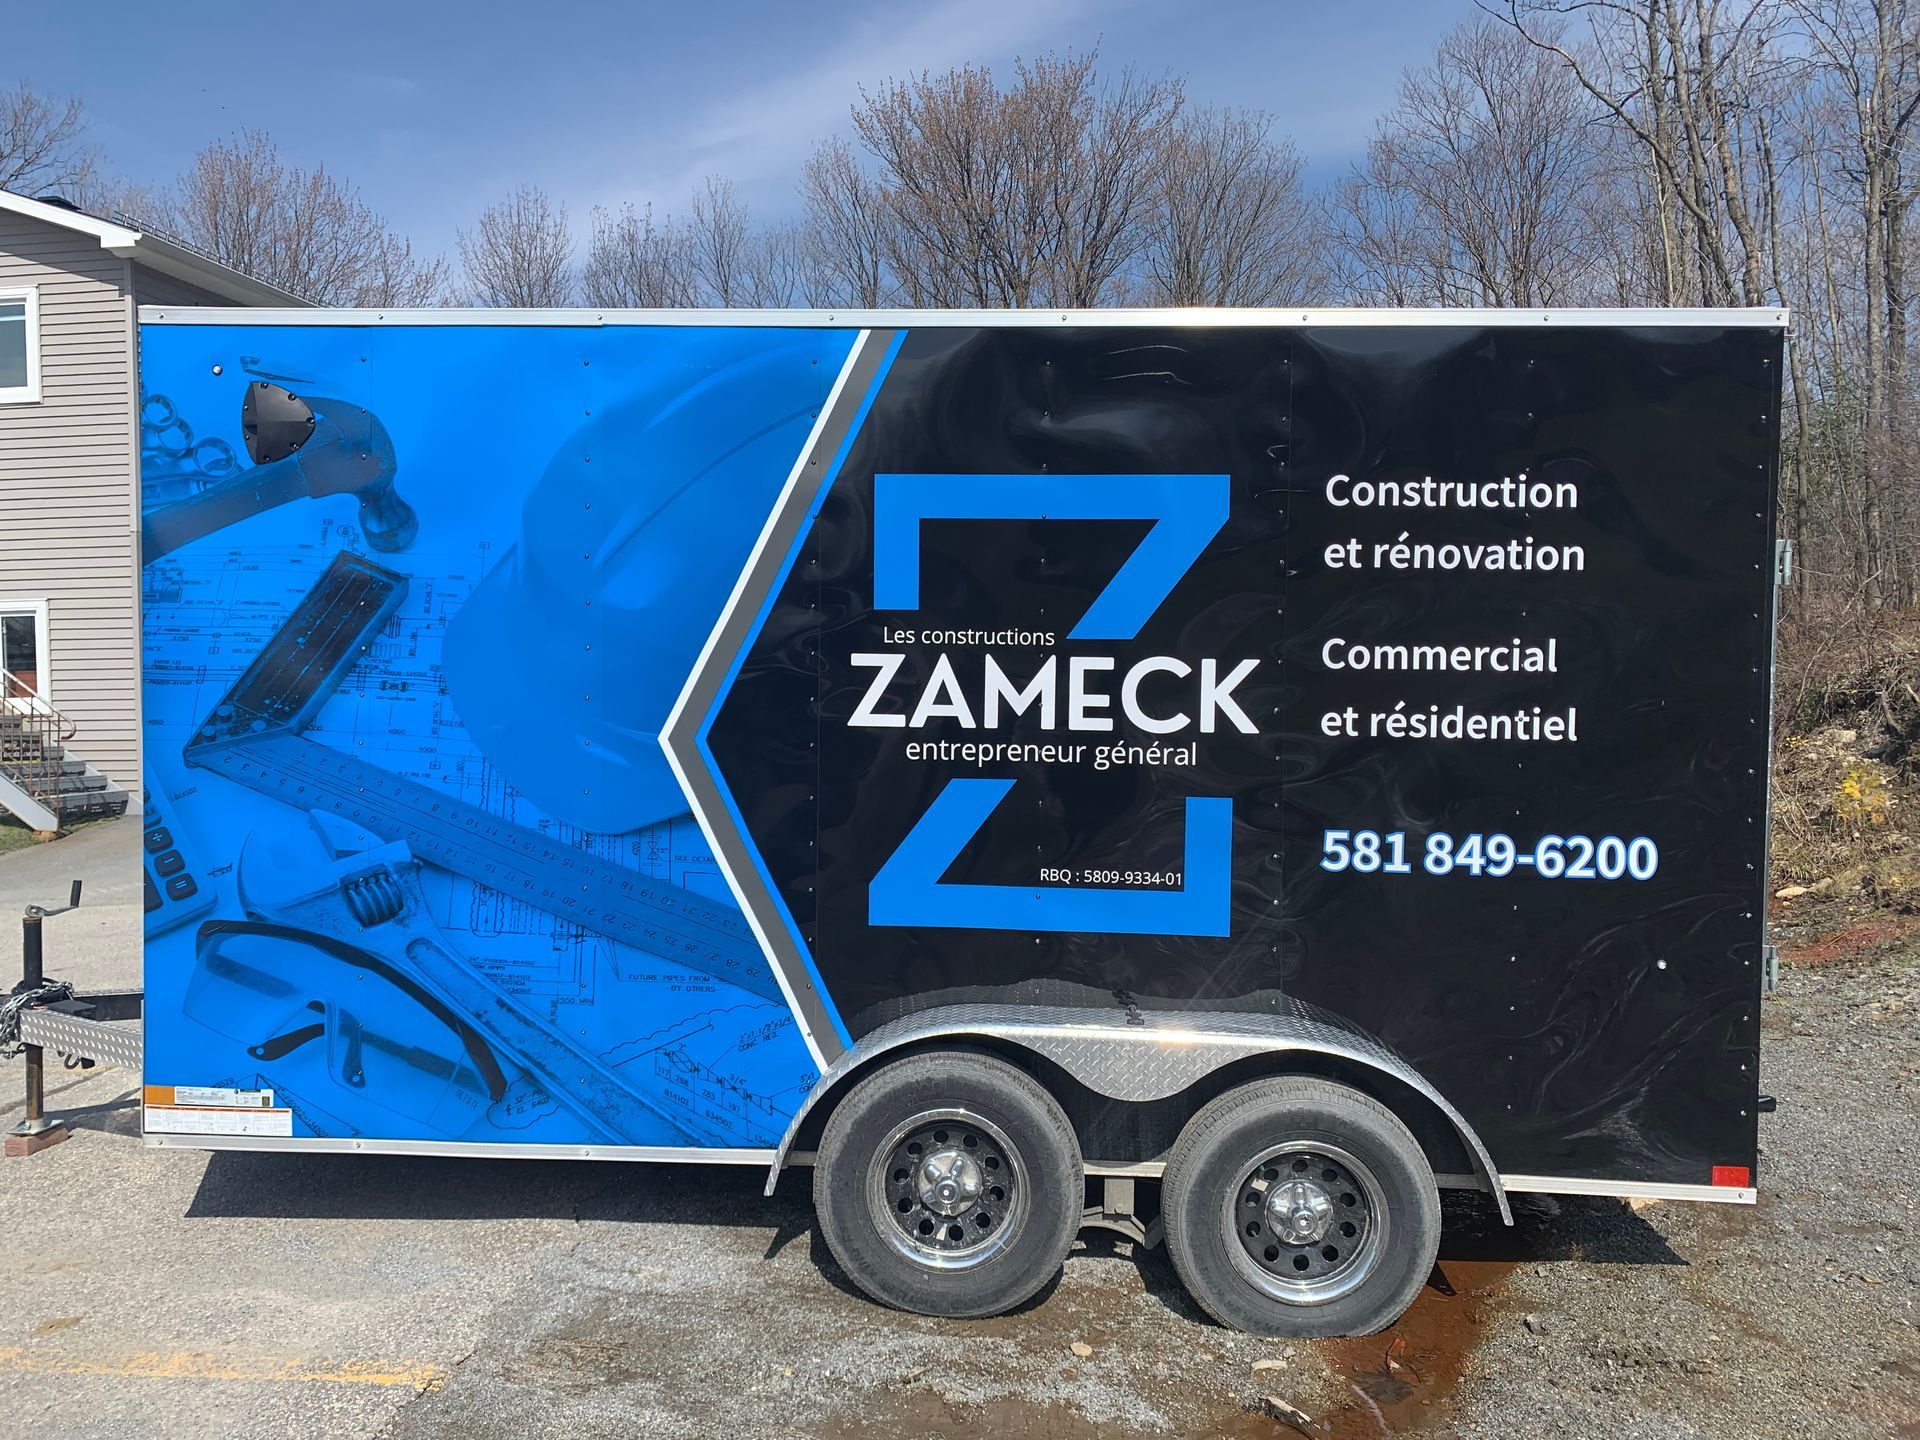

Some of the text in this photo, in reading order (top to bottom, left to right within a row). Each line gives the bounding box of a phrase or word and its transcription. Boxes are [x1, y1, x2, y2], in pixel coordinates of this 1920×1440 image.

[1325, 474, 1578, 508] Construction
[1324, 531, 1585, 571] et rénovation
[883, 626, 1056, 646] Les constructions
[1321, 638, 1557, 673] Commercial
[847, 652, 1261, 735] ZAMECK
[1320, 700, 1577, 742] et résidentiel
[905, 738, 1197, 770] entrepreneur général
[1320, 829, 1660, 880] 581 849-6200
[1040, 868, 1072, 884] RBQ
[1083, 870, 1182, 886] 5809-9334-01
[663, 974, 686, 982] PIPES
